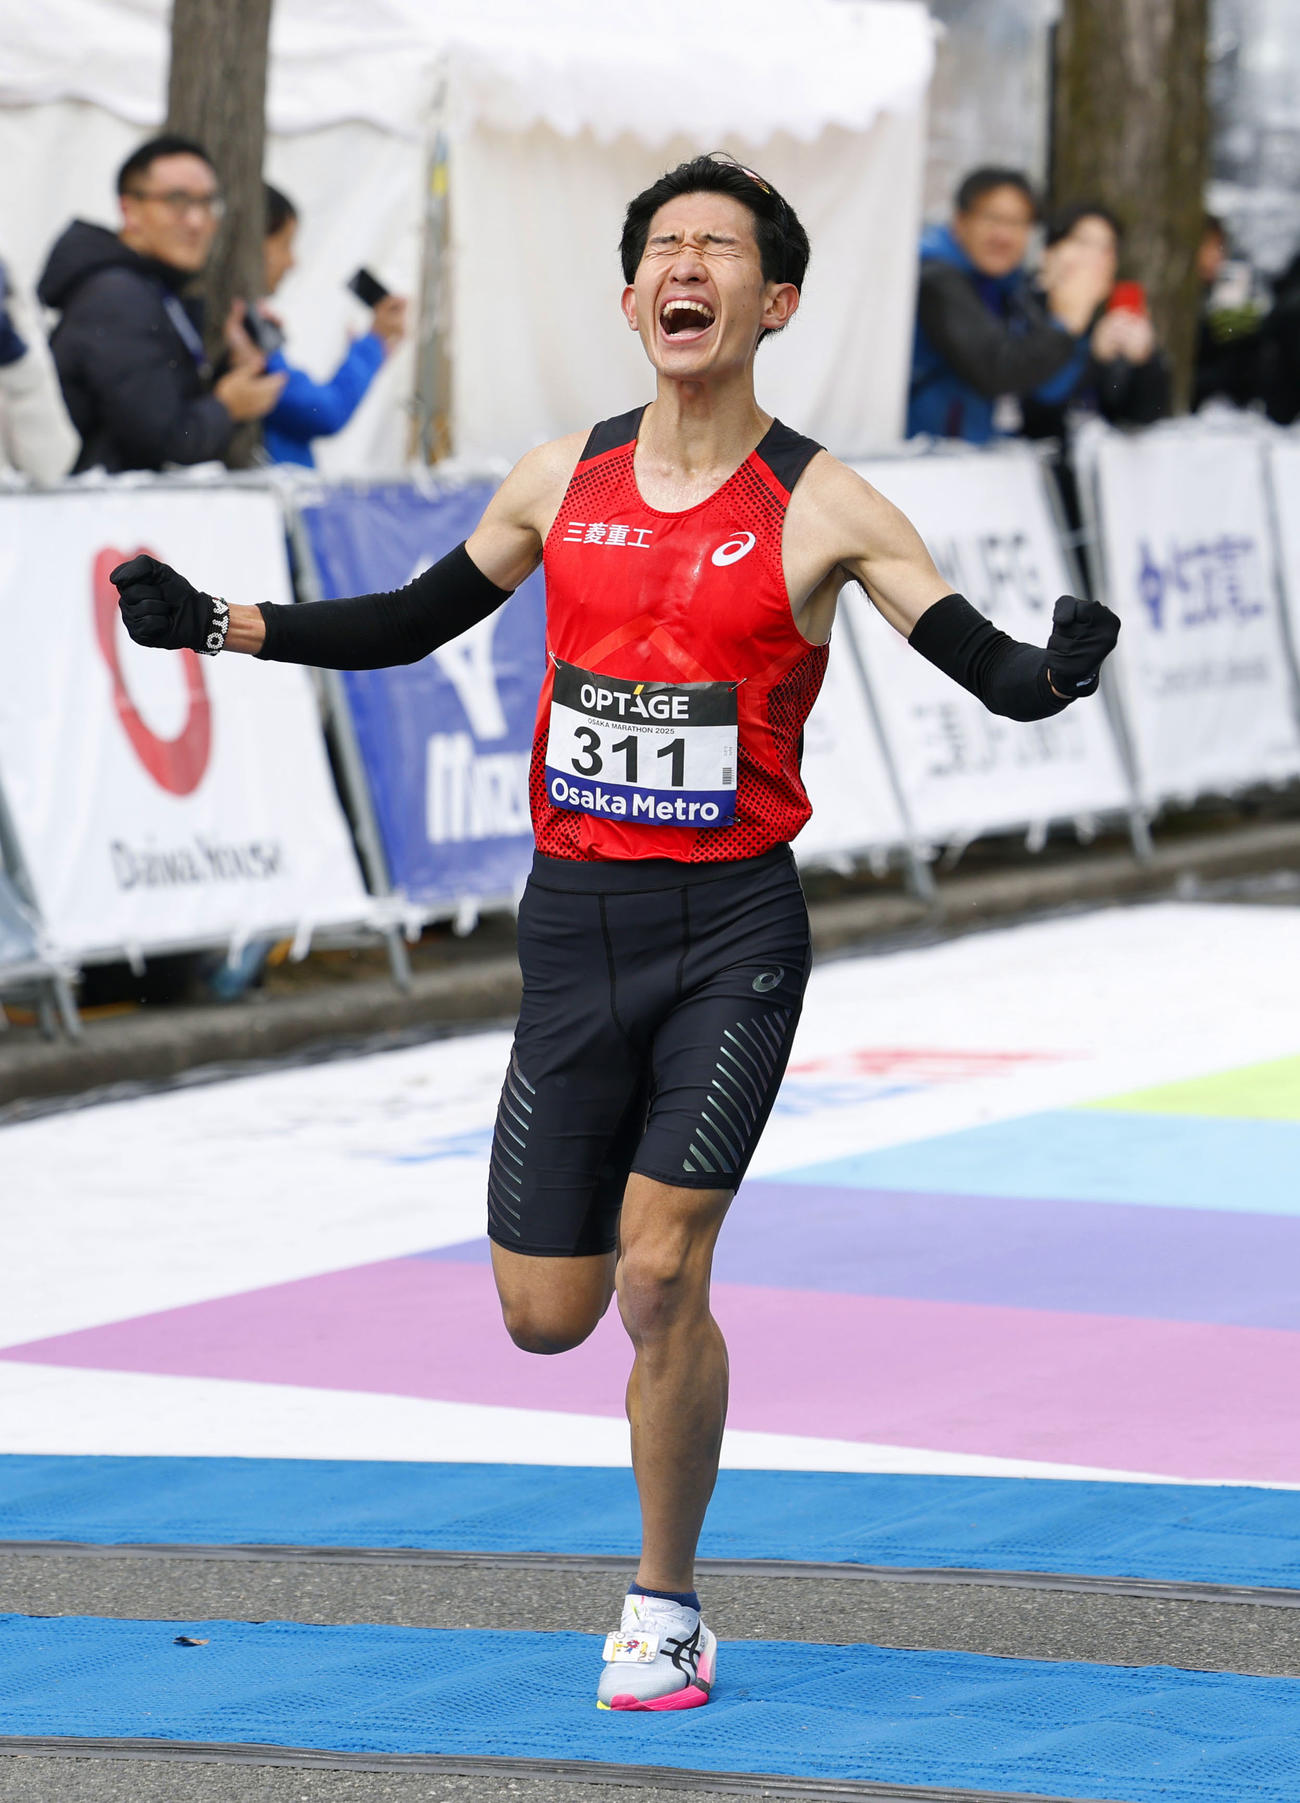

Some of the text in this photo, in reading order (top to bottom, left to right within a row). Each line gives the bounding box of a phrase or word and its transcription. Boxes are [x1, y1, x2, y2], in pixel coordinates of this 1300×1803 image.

[563, 522, 653, 548] 三菱重工
[580, 684, 690, 719] OPTAGE
[587, 718, 675, 735] OSAKA MARATHON 2025
[571, 726, 685, 788] 311
[551, 777, 720, 822] Osaka Metro
